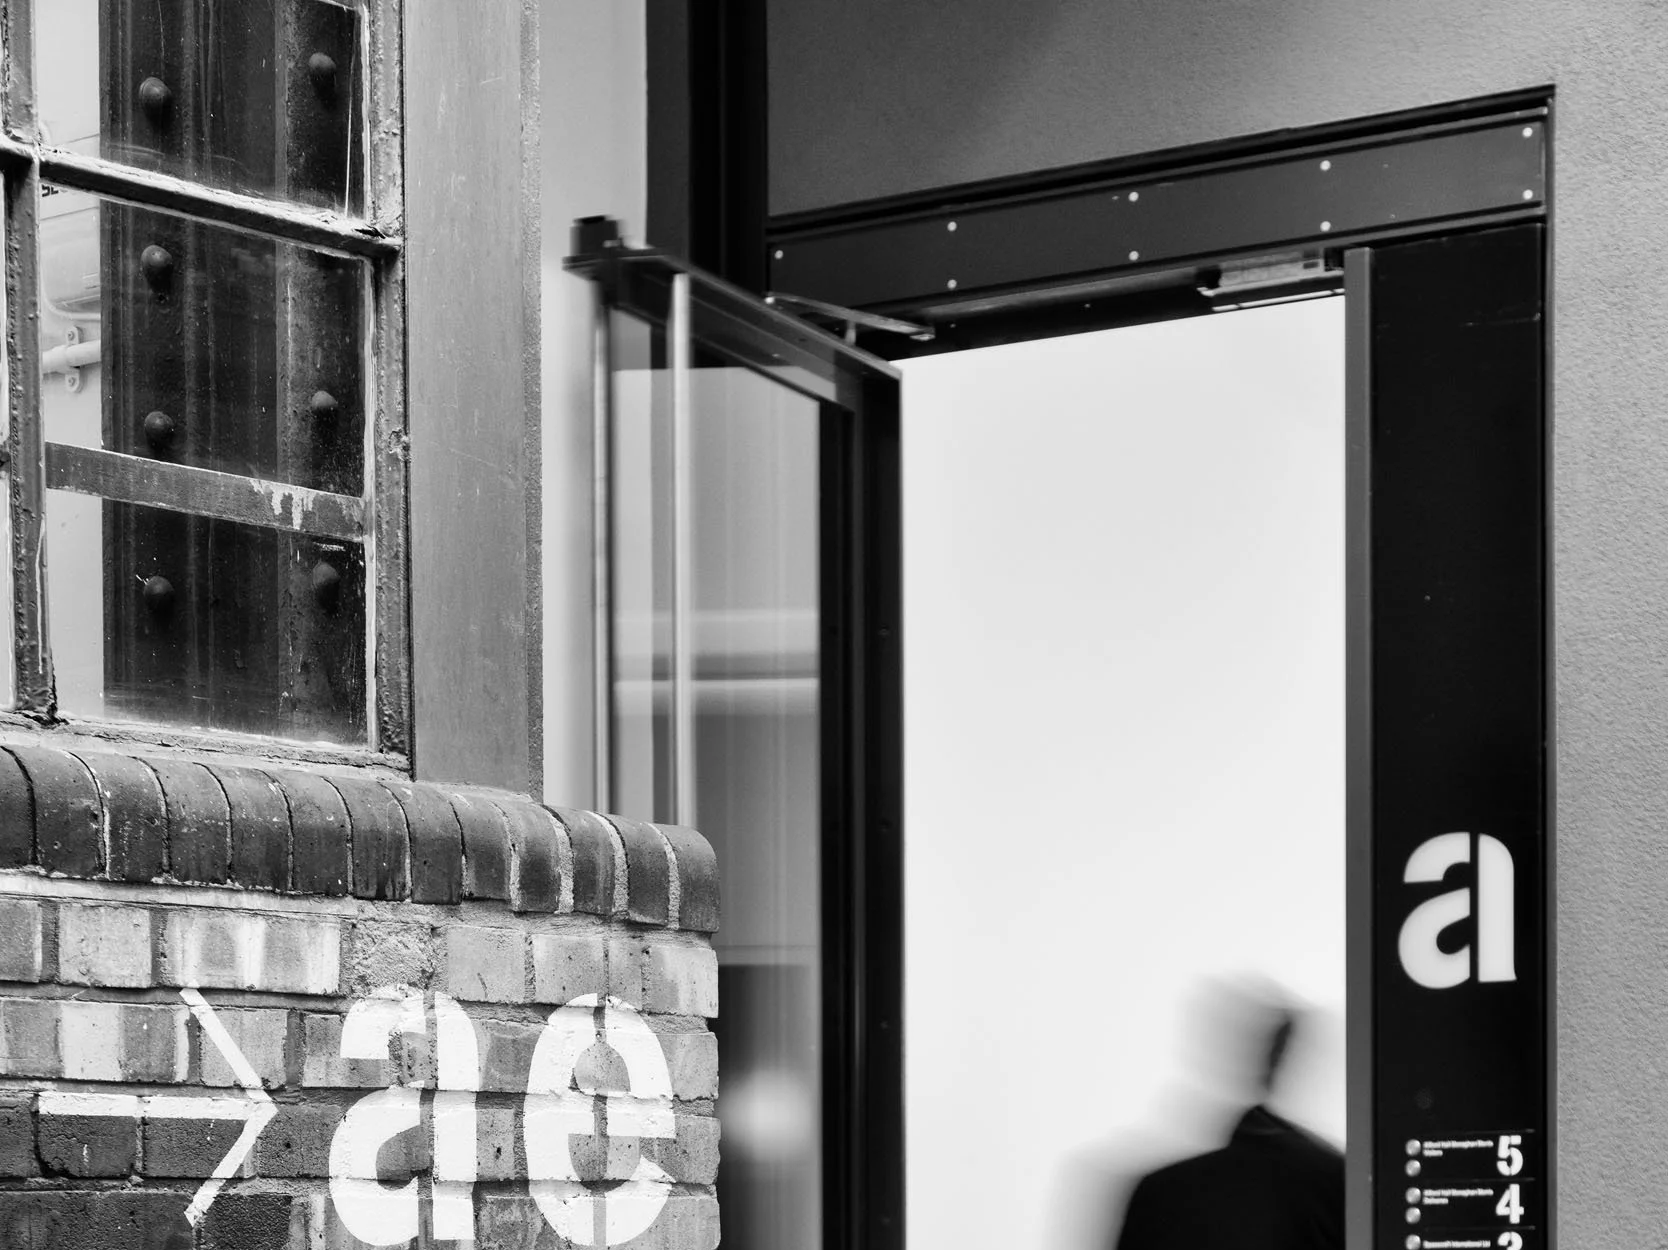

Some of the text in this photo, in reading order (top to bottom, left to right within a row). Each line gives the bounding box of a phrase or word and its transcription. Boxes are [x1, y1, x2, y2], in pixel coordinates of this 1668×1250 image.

[1398, 831, 1516, 989] a
[1496, 1135, 1524, 1176] 5
[1495, 1184, 1525, 1224] 4
